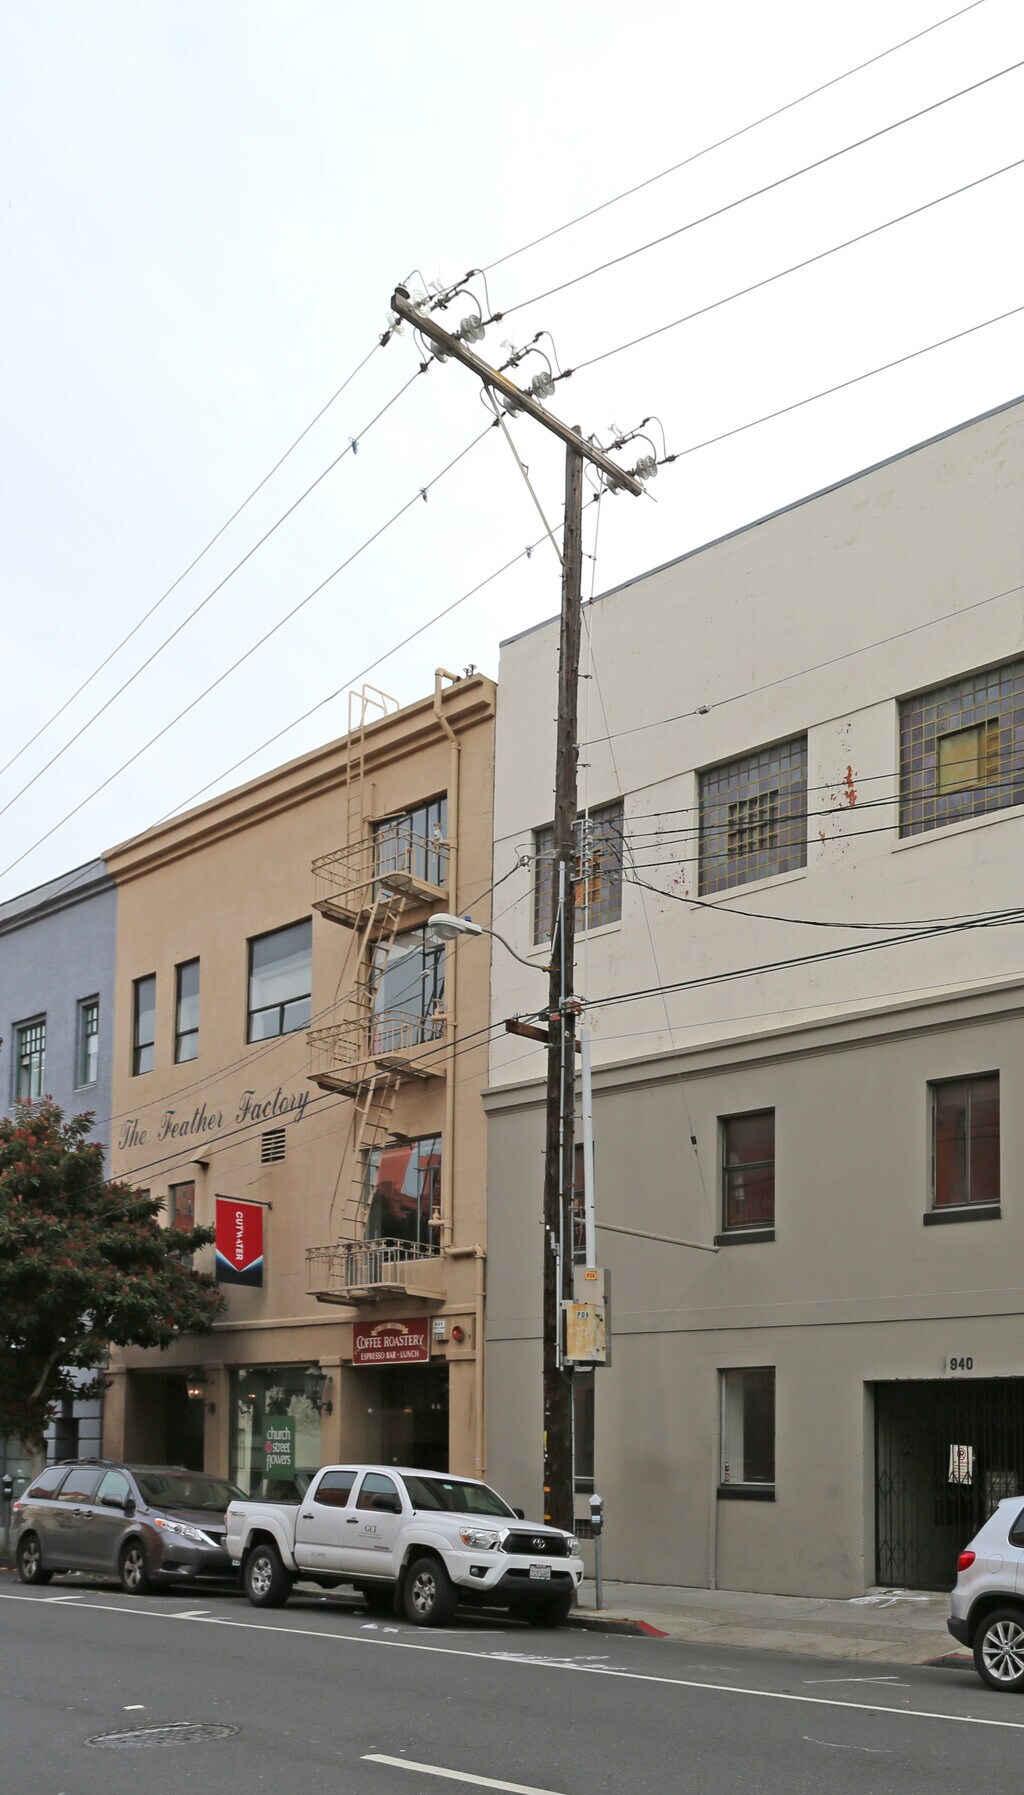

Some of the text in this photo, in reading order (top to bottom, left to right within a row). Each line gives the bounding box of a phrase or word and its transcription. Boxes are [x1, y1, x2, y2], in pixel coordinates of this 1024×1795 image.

[118, 1087, 310, 1150] The Feather Factory
[235, 1211, 244, 1261] CUTWATER
[356, 1334, 425, 1350] COFFEE ROASTERY
[360, 1349, 420, 1361] ESPRESSO BAR LUNCH
[950, 1357, 974, 1371] 940
[266, 1426, 291, 1441] church
[272, 1442, 291, 1453] street
[266, 1454, 291, 1472] flowers
